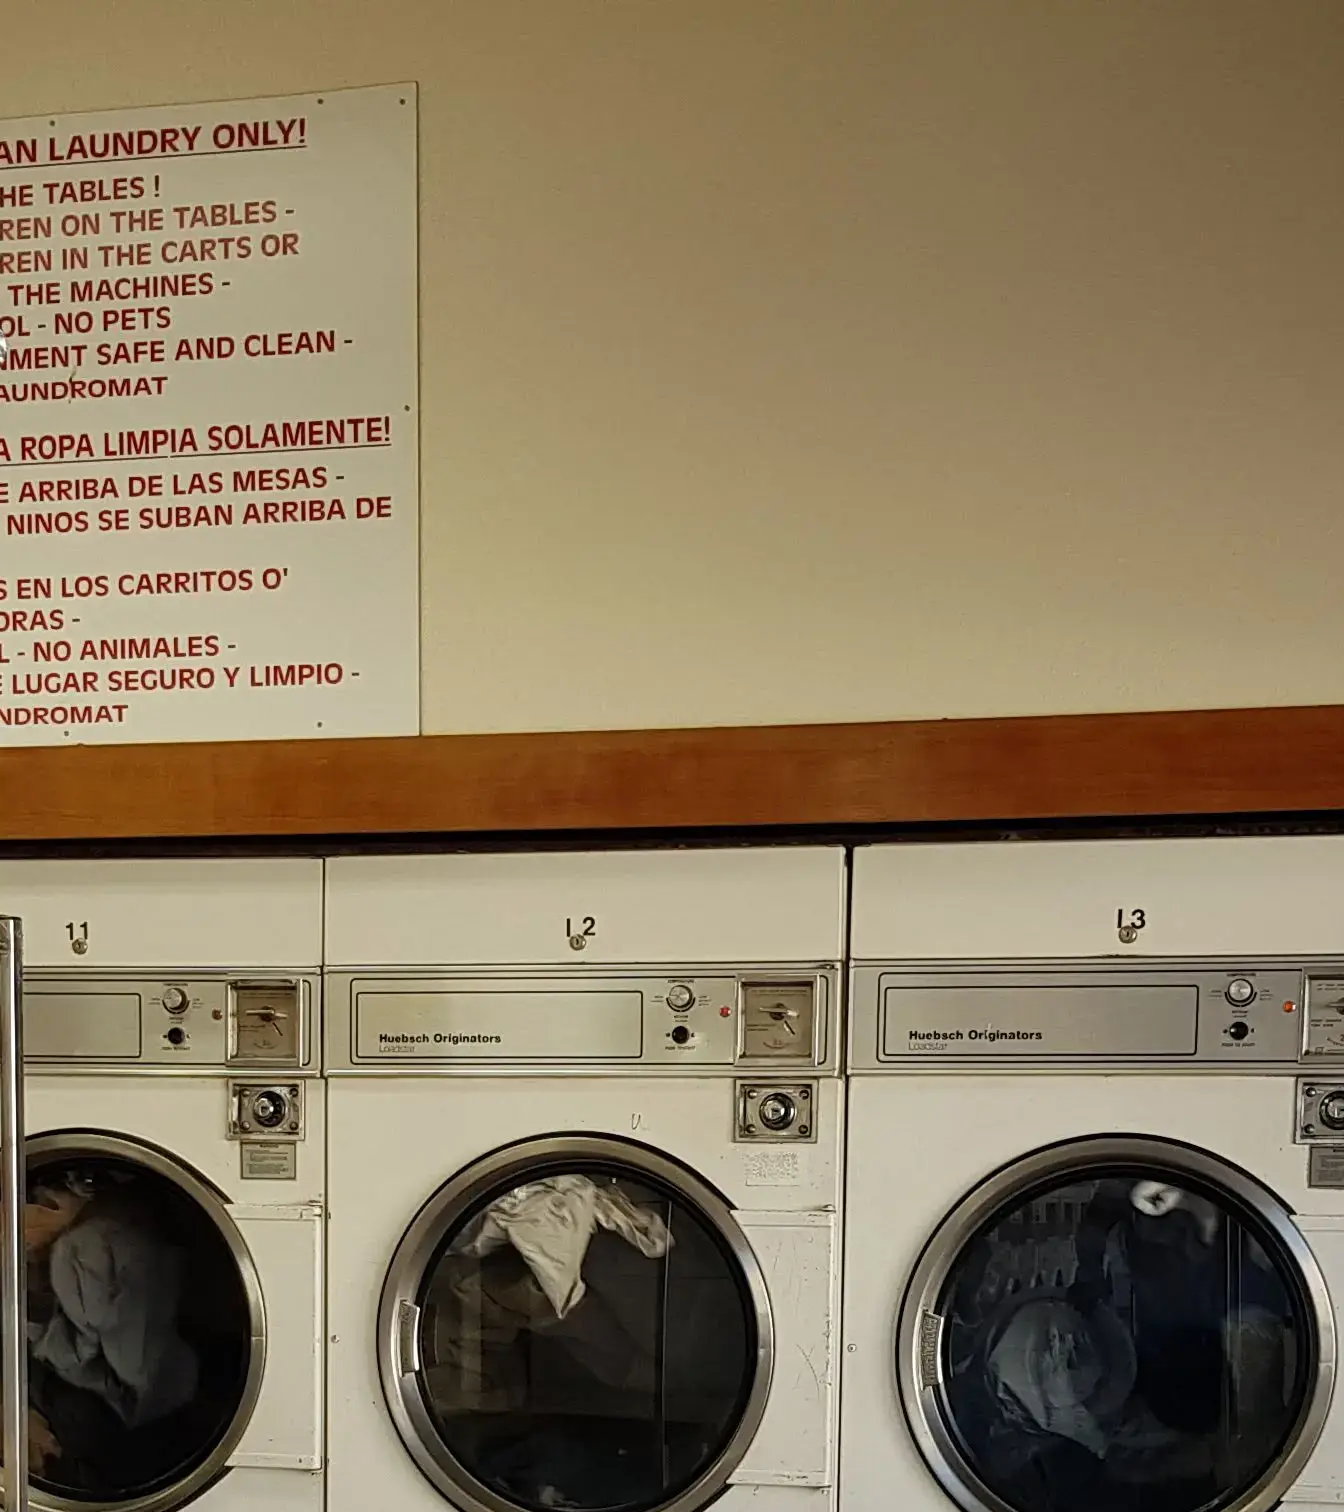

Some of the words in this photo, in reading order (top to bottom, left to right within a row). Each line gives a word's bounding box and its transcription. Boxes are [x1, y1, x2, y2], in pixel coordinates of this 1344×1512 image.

[49, 127, 202, 162] LAUNDRY
[212, 119, 306, 150] ONLY!
[43, 176, 145, 205] TABLES
[61, 214, 100, 237] ON
[112, 209, 162, 232] THE
[172, 202, 277, 229] TABLES
[62, 248, 88, 269] IN
[100, 242, 150, 267] THE
[161, 236, 251, 263] CARTS
[261, 233, 299, 257] OR
[7, 282, 61, 305] THE
[70, 272, 214, 302] MACHINES
[54, 311, 94, 335] NO
[102, 305, 171, 331] PETS
[96, 340, 164, 366] SAFE
[175, 336, 235, 361] AND
[244, 330, 335, 358] CLEAN
[20, 434, 95, 461] ROPA
[104, 427, 199, 457] LIMPIA
[207, 415, 390, 452] SOLAMENTE!
[19, 477, 120, 502] ARRIBA
[128, 474, 163, 498] DE
[173, 471, 224, 496] LAS
[233, 466, 328, 493] MESAS
[7, 510, 89, 536] NINOS
[98, 509, 129, 532] SE
[139, 504, 233, 529] SUBAN
[242, 498, 346, 525] ARRIBA
[356, 496, 392, 519] DE
[17, 578, 52, 600] EN
[61, 575, 109, 598] LOS
[118, 569, 253, 596] CARRITOS
[33, 640, 72, 663] NO
[80, 635, 219, 661] ANIMALES
[12, 671, 99, 695] LUGAR
[108, 667, 215, 692] SEGURO
[223, 667, 239, 687] Y
[250, 662, 343, 687] LIMPIO
[65, 922, 90, 941] 11
[565, 916, 597, 937] 12
[1116, 908, 1147, 931] 13
[379, 1033, 430, 1043] Huebsch
[433, 1033, 502, 1045] Originators
[908, 1030, 964, 1041] Huebsch
[968, 1029, 1043, 1042] Originators
